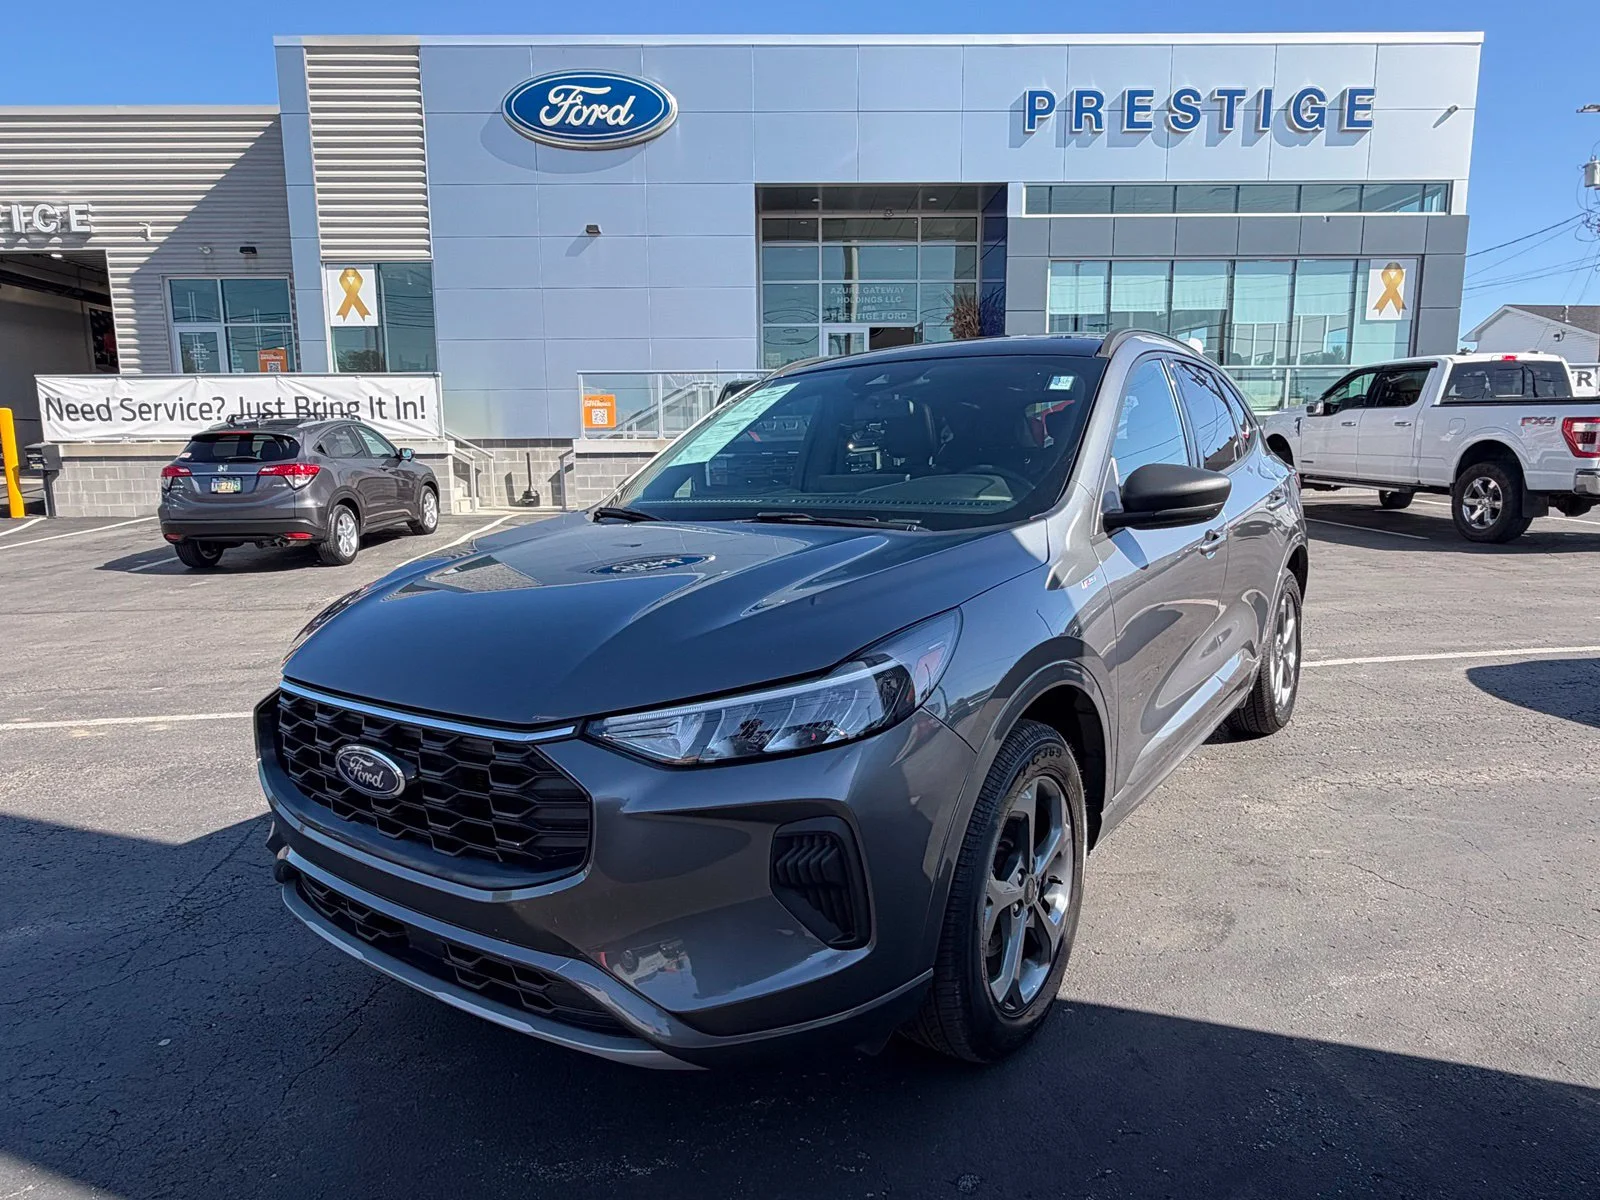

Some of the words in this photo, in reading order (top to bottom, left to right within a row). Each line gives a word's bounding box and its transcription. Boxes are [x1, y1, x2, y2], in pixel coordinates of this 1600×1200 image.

[539, 84, 636, 126] Ford
[1024, 86, 1375, 133] PRESTIGE
[836, 296, 883, 304] HOLDINGS
[831, 312, 879, 321] PRESTIGE
[882, 312, 908, 320] FORD
[45, 396, 112, 422] Need
[119, 396, 225, 422] Service?
[234, 395, 285, 421] Just
[294, 395, 361, 421] Bring
[369, 395, 388, 420] It
[395, 395, 426, 420] In!
[347, 755, 384, 788] Ford
